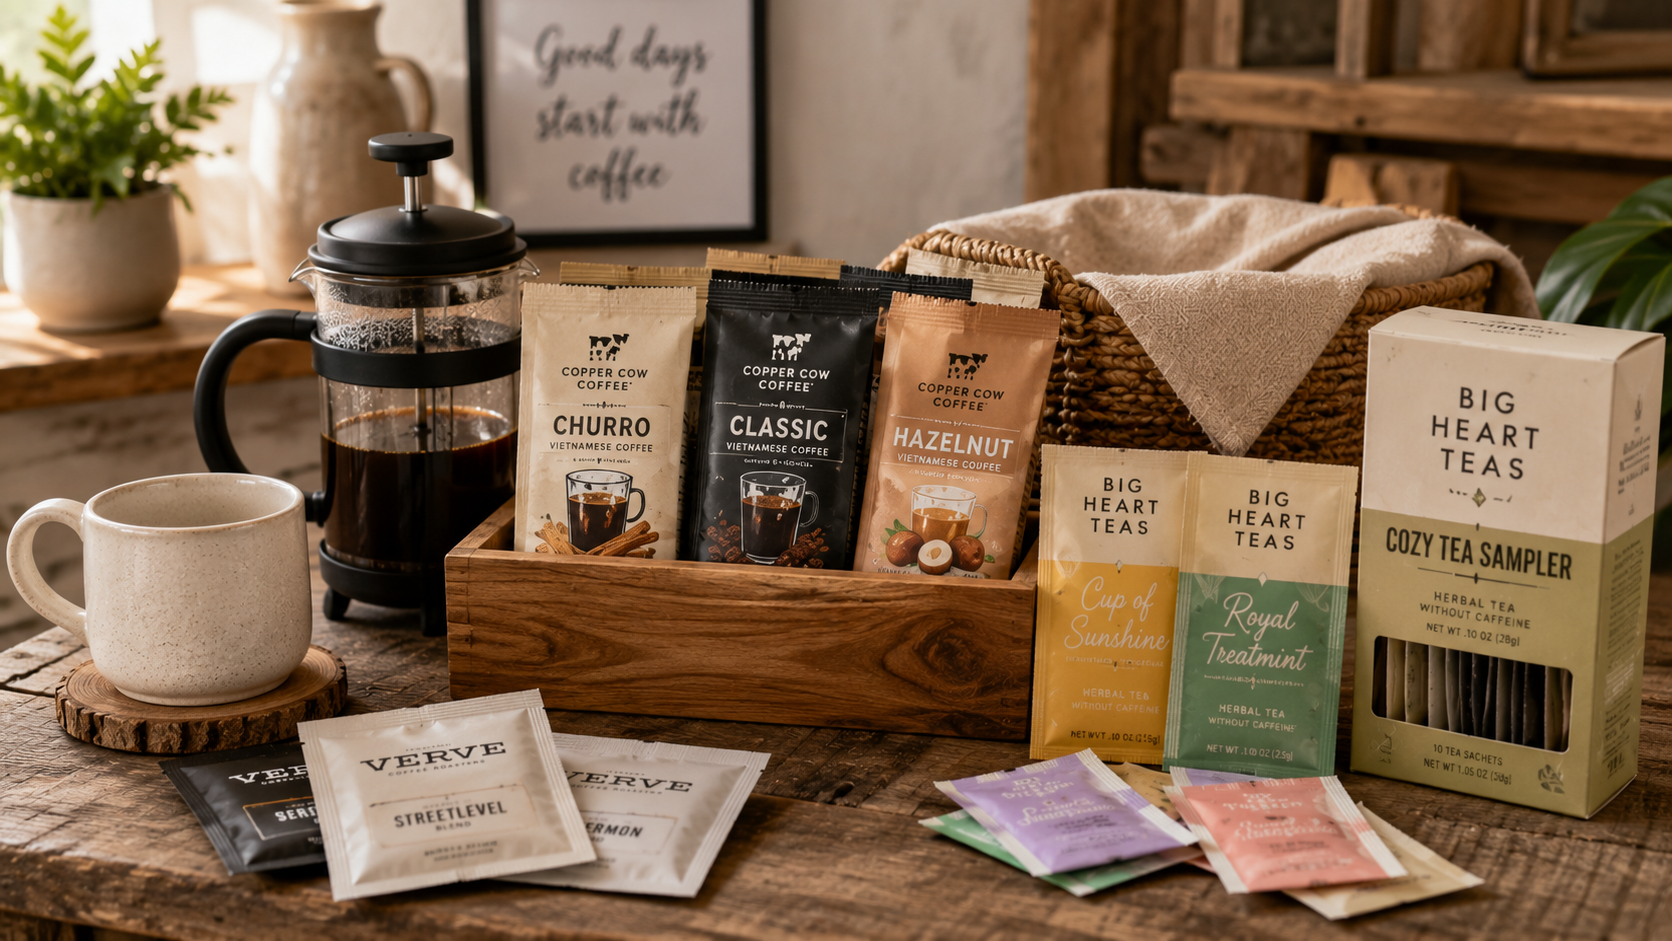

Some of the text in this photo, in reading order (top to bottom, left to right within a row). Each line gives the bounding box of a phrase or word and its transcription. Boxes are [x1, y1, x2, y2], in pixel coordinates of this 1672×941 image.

[533, 23, 707, 88] Good days
[535, 89, 706, 141] start with
[569, 146, 668, 202] coffee
[561, 367, 648, 379] COPPER COW
[743, 366, 830, 380] COPPER COW
[577, 380, 628, 391] COFFEE
[759, 380, 810, 392] COFFEE
[918, 382, 1005, 400] COPPER COW
[933, 397, 984, 412] COFFEE
[1459, 387, 1515, 414] BIG
[553, 415, 650, 437] CHURRO
[730, 415, 828, 441] CLASSIC
[1431, 415, 1539, 449] HEART
[550, 441, 653, 452] VIETNAMESE COFFEE
[726, 442, 829, 456] VIETNAMESE COFFEE
[893, 426, 1014, 459] HAZELNUT
[898, 453, 958, 468] VIETNAMESE
[1440, 448, 1524, 480] TEAS
[1104, 477, 1142, 493] BIG
[1084, 496, 1158, 514] HEART
[1249, 489, 1289, 507] BIG
[1091, 518, 1148, 535] TEAS
[1228, 509, 1306, 530] HEART
[1235, 531, 1295, 551] TEAS
[1386, 527, 1572, 580] COZY TEA SAMPLER
[1081, 576, 1158, 622] Cup of
[1434, 591, 1515, 613] HERBAL TEA
[1223, 592, 1299, 641] Royal
[1420, 603, 1531, 629] WITHOUT CAFFEINE
[1064, 614, 1170, 650] Sunshine
[1426, 623, 1444, 633] NET
[1447, 626, 1461, 636] WT
[1202, 632, 1314, 671] Treatmint
[1083, 688, 1125, 699] HERBAL
[1072, 701, 1113, 711] WITHOUT
[1219, 704, 1285, 719] HERBAL TEA
[1208, 716, 1249, 727] WITHOUT
[360, 742, 506, 771] VERVE
[1206, 744, 1224, 753] NET
[1225, 746, 1239, 755] WT
[1433, 744, 1503, 766] 10 TEA SACHETS
[388, 767, 428, 777] COFFEE
[1424, 758, 1440, 769] NET
[1443, 762, 1455, 772] WT
[1458, 765, 1474, 776] 1.05
[565, 770, 693, 792] VERVE
[394, 801, 507, 828] STREETLEVEL
[436, 821, 471, 831] BLEND
[585, 822, 643, 838] ERMON
